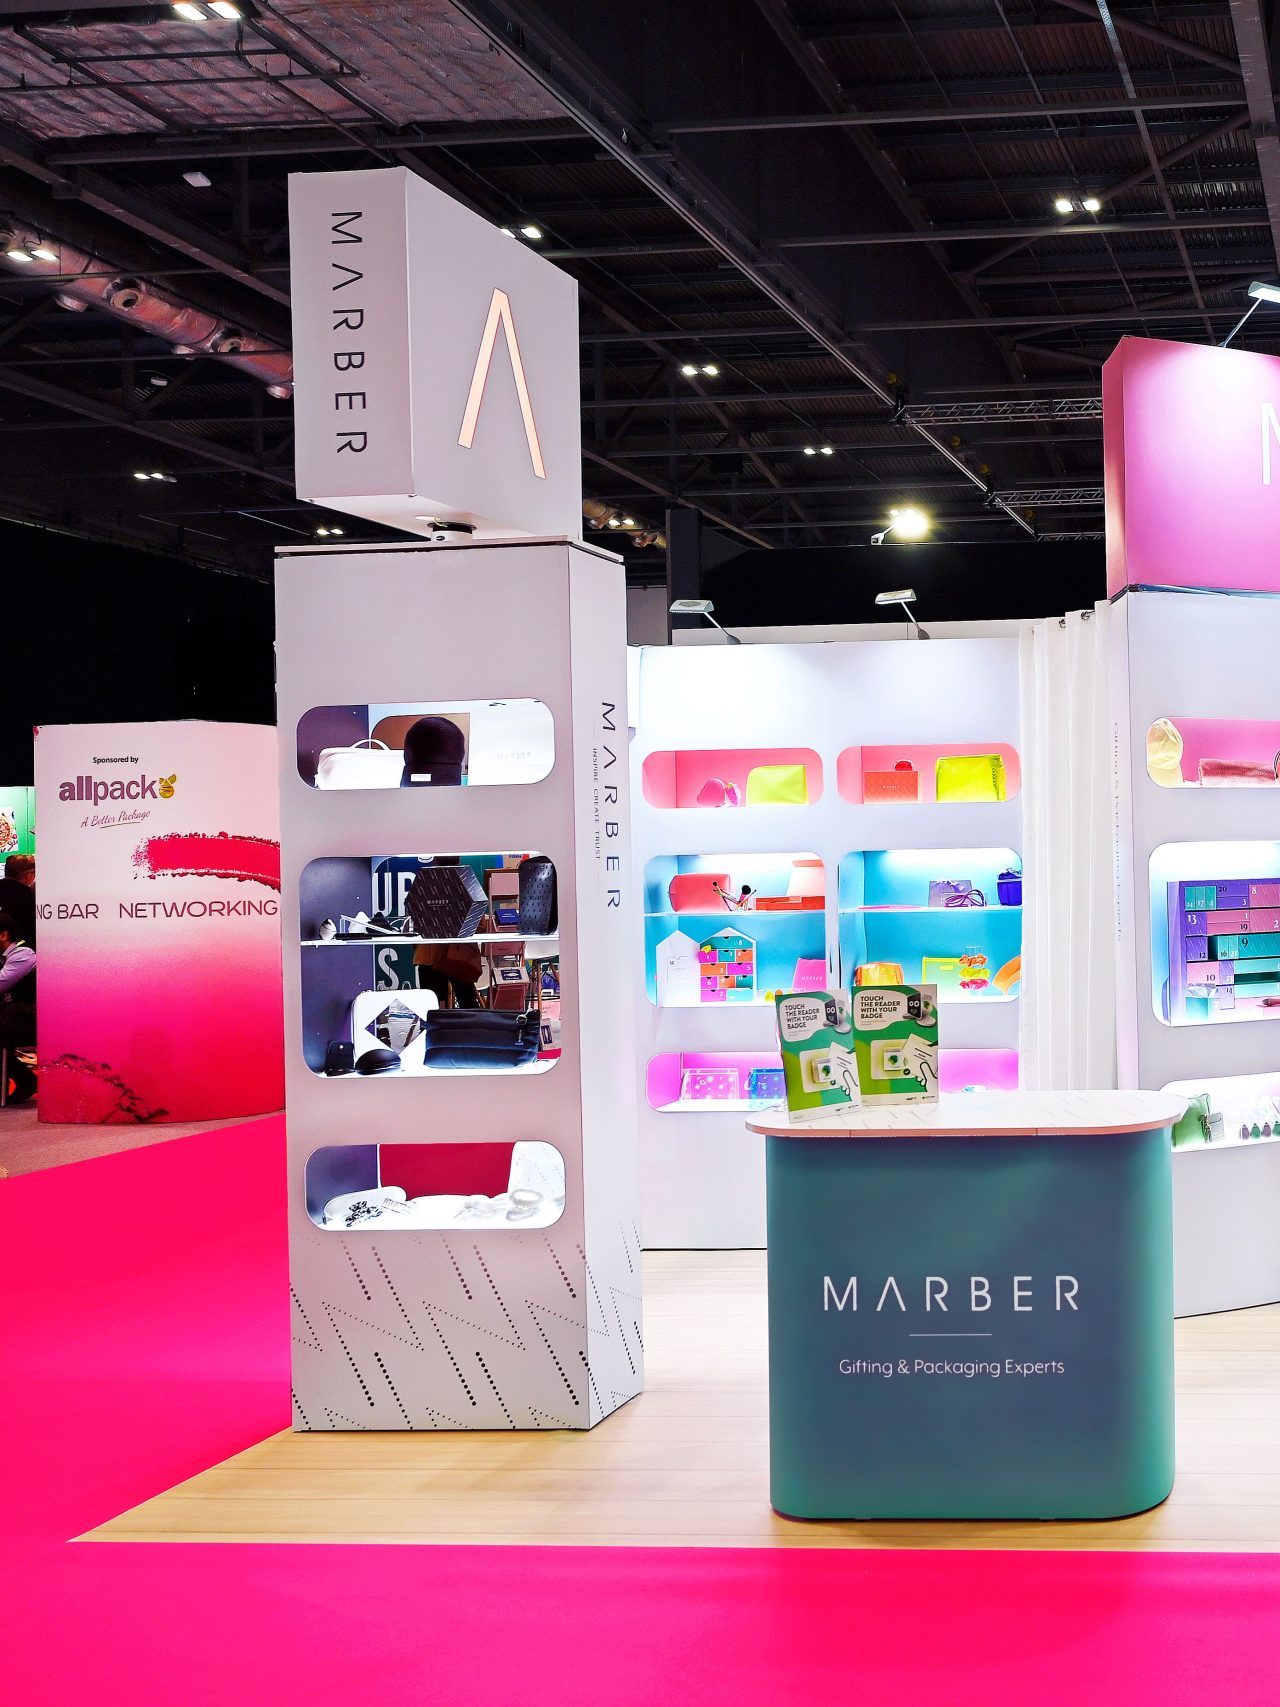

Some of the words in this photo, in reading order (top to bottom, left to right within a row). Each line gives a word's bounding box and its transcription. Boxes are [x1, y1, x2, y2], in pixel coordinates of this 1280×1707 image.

[331, 211, 368, 453] MARBER
[92, 756, 129, 765] Sponsored
[130, 756, 139, 764] by
[59, 775, 158, 806] allpack
[602, 702, 621, 907] MARBER
[81, 817, 89, 828] A
[91, 815, 115, 827] Better
[118, 809, 151, 823] Package
[1251, 886, 1257, 895] 8
[1242, 898, 1247, 906] 3
[57, 903, 99, 920] BAR
[119, 900, 278, 918] NETWORKING
[1187, 914, 1197, 925] 13
[1273, 920, 1280, 928] 2
[1240, 923, 1248, 931] 19
[1241, 938, 1248, 948] 9
[785, 1003, 805, 1011] TOUCH
[798, 1008, 820, 1016] READER
[787, 1022, 807, 1030] BADGE
[823, 1275, 1079, 1312] MARBER
[839, 1359, 893, 1378] Gifting
[897, 1360, 911, 1374] &
[914, 1359, 1001, 1378] Packaging
[1005, 1359, 1065, 1378] Experts
